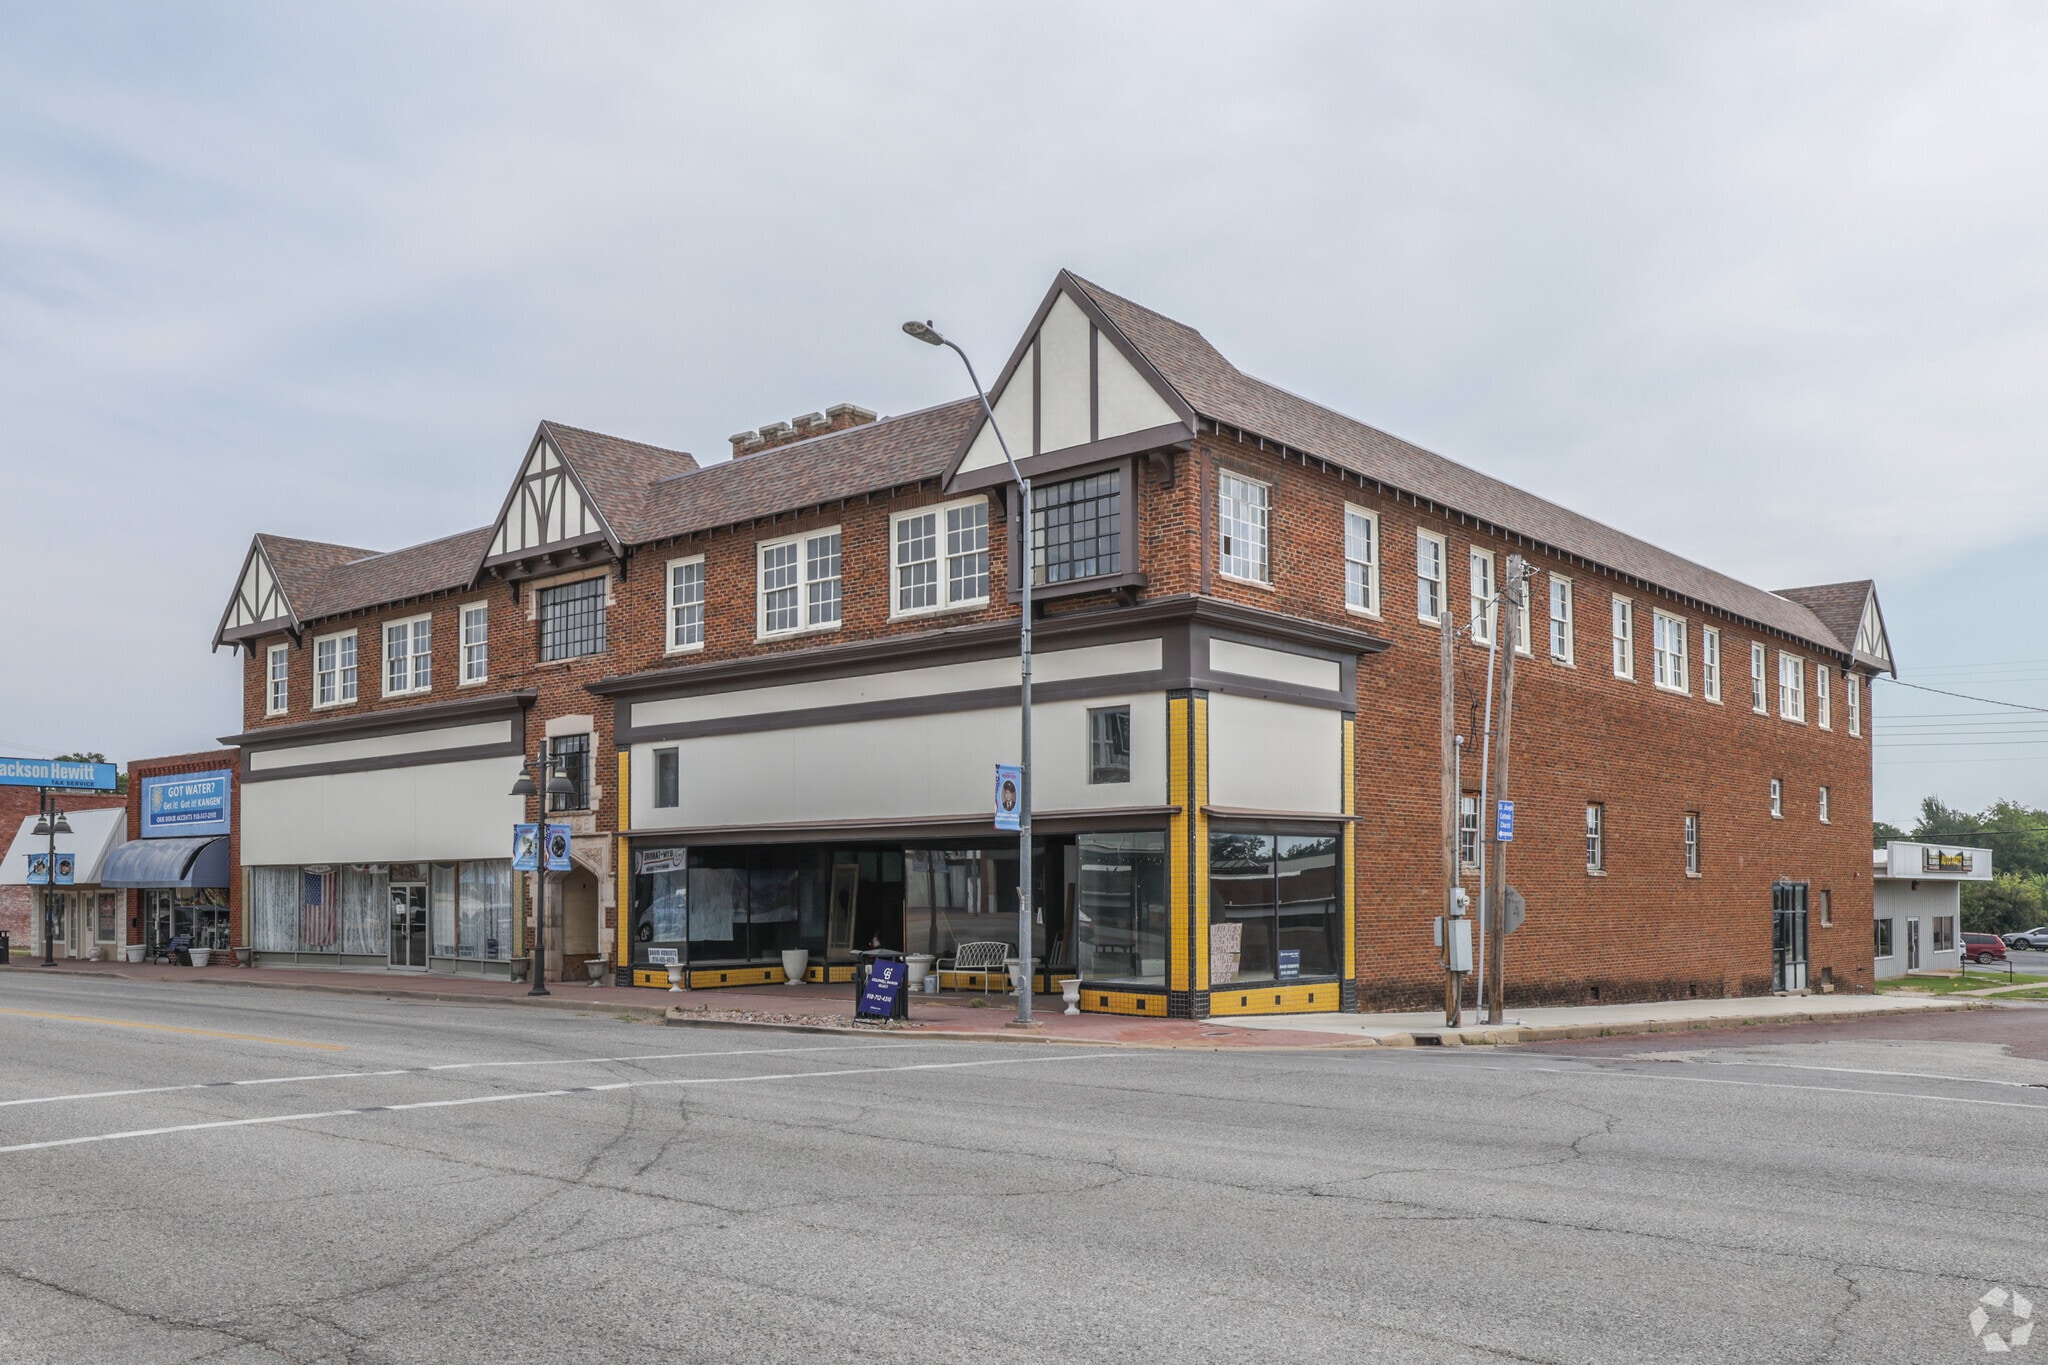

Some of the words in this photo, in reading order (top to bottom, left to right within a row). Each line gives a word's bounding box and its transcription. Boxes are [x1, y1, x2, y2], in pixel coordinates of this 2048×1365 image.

[51, 763, 94, 780] Hewitt
[168, 786, 183, 797] GOT
[185, 782, 215, 795] WATER?
[163, 801, 173, 810] Get
[180, 800, 191, 809] Got
